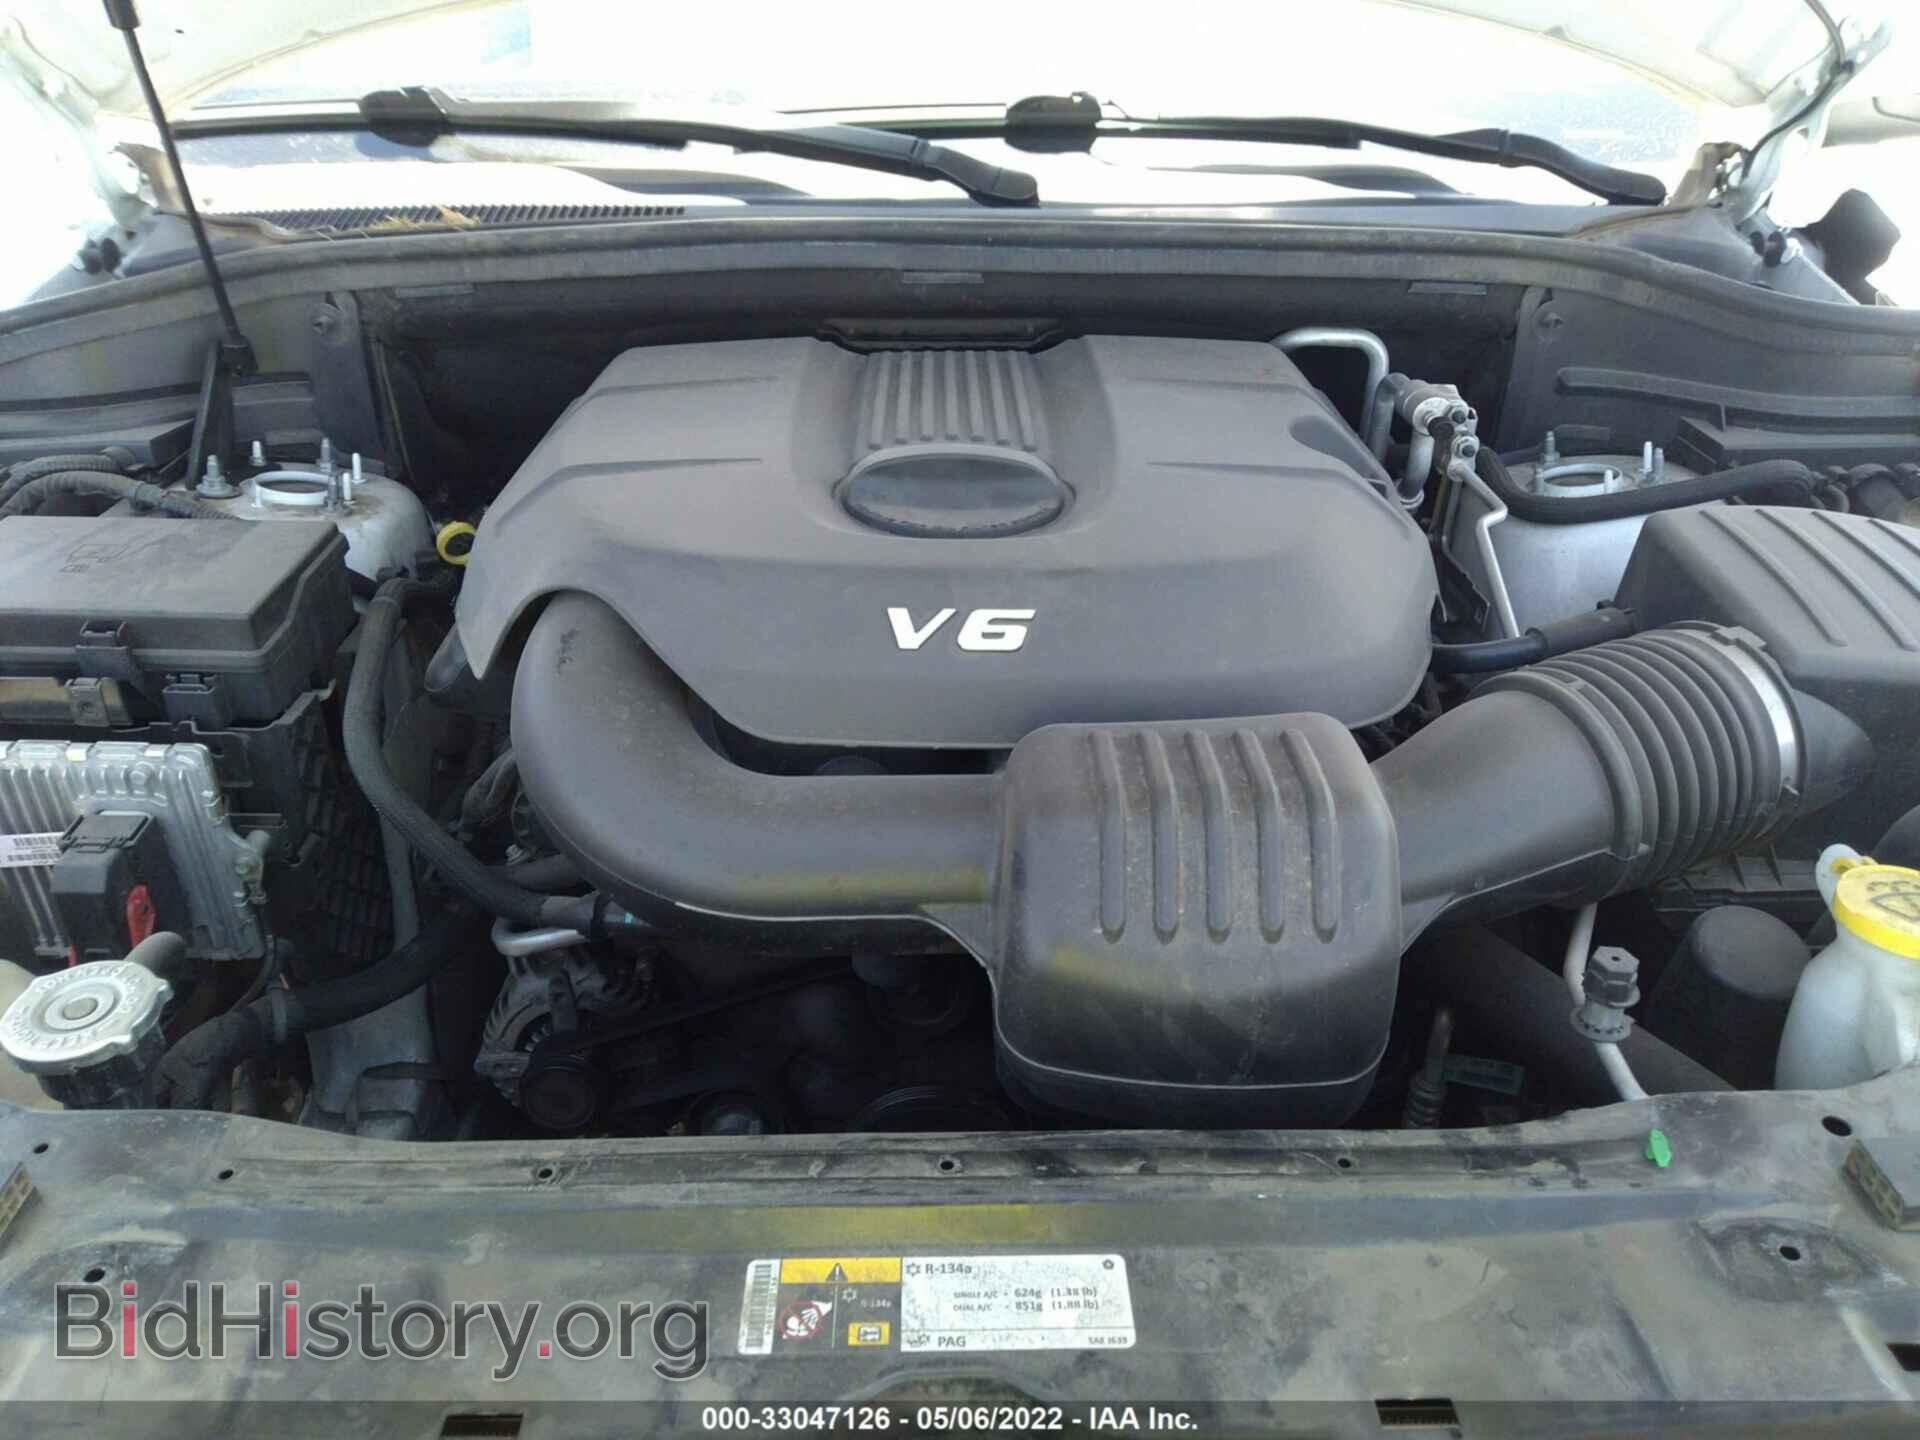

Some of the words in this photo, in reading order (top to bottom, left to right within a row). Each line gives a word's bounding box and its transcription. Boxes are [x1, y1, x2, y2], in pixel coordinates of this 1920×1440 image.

[887, 608, 1037, 651] V6
[925, 1263, 972, 1274] R-134a
[1014, 1288, 1042, 1299] 624g
[1082, 1287, 1098, 1298] lb)
[1015, 1301, 1043, 1312] 851g
[1083, 1300, 1099, 1311] lb)
[937, 1335, 966, 1347] PAG
